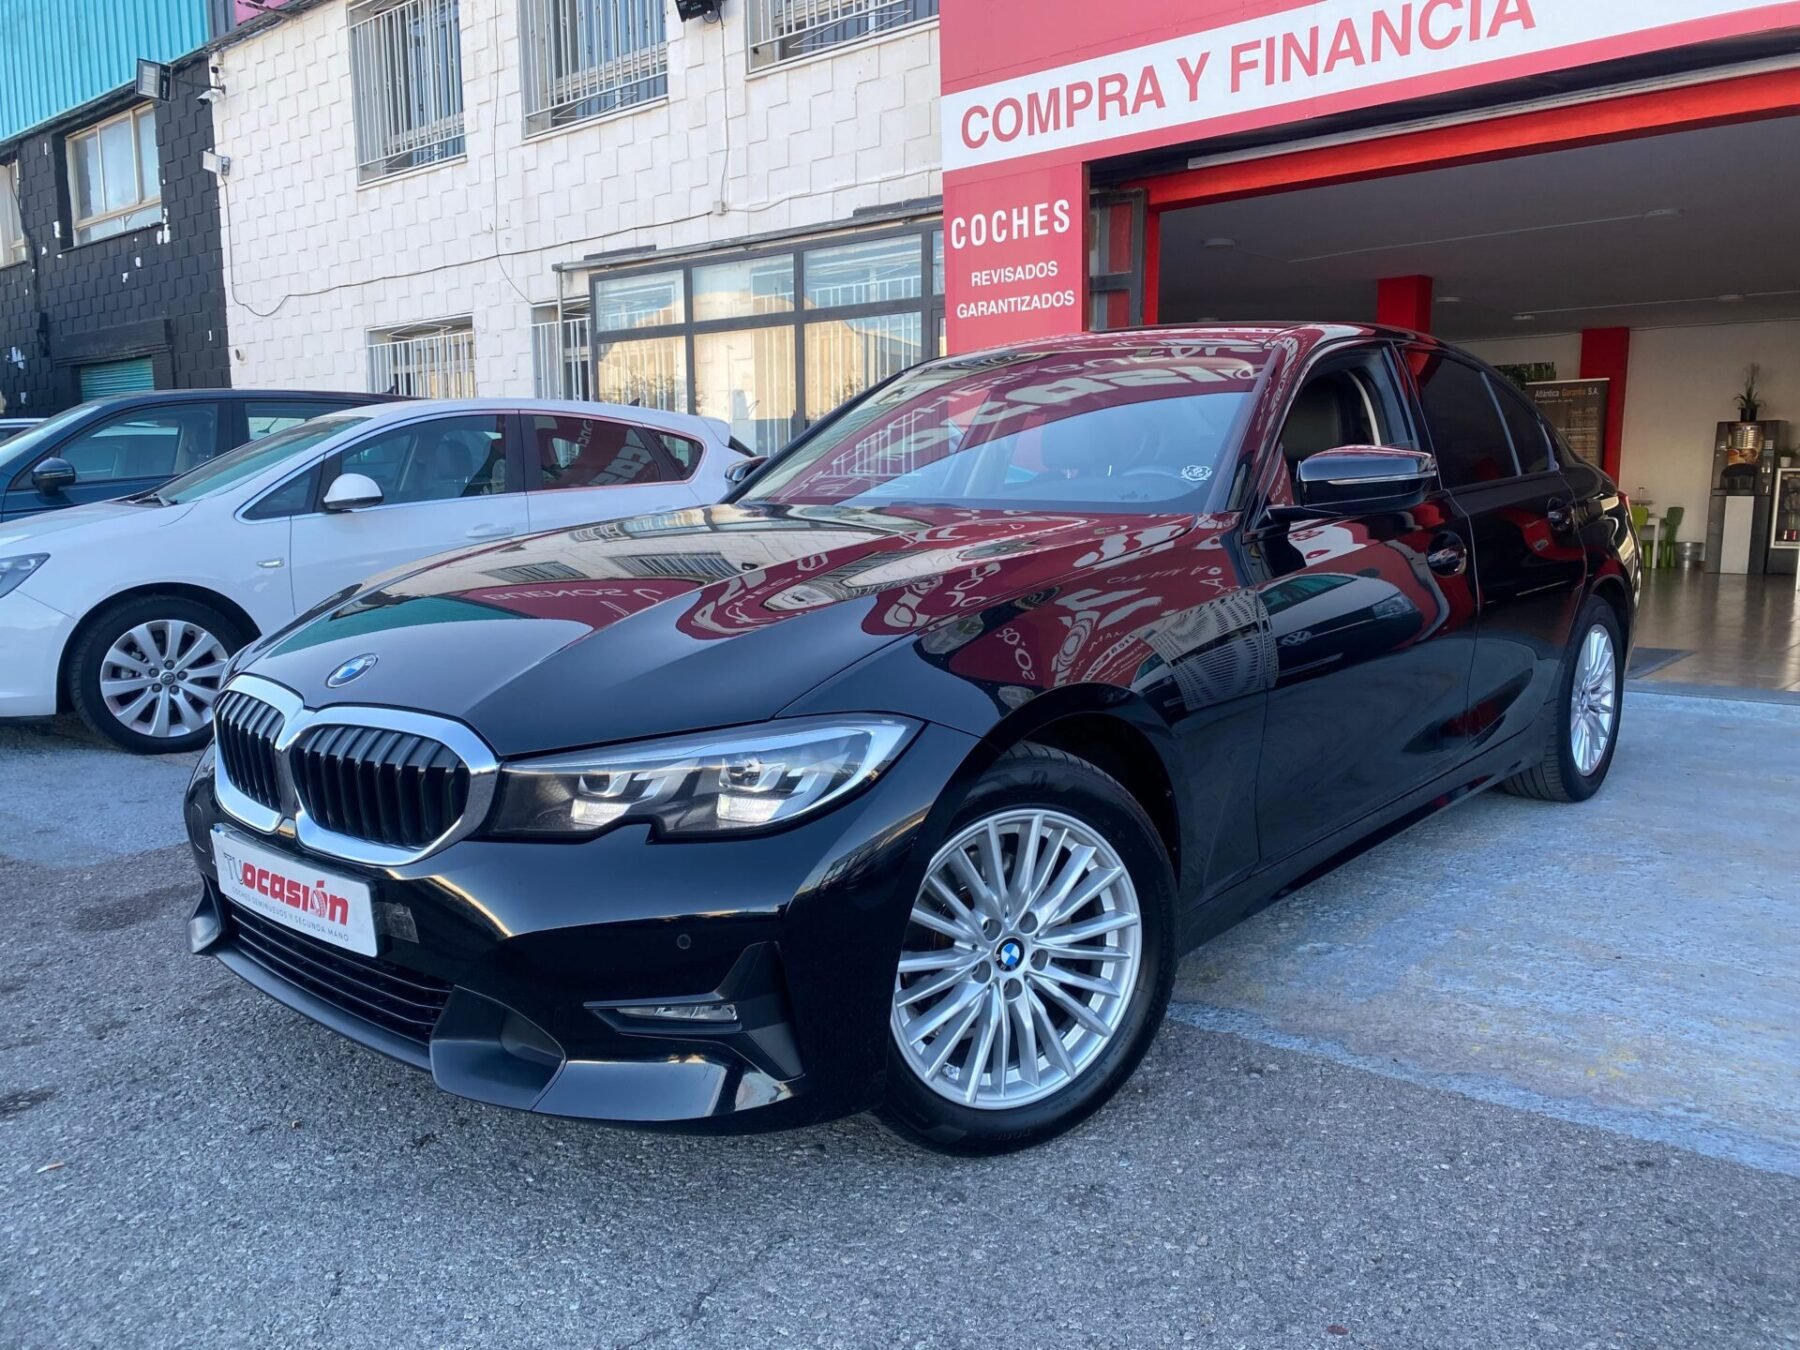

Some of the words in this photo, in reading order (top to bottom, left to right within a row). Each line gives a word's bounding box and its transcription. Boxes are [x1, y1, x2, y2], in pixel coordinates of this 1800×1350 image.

[961, 65, 1166, 149] COMPRA
[1176, 52, 1211, 101] Y
[1231, 0, 1536, 93] FINANCIA
[951, 199, 1070, 249] COCHES
[971, 260, 1058, 287] REVISADOS
[957, 290, 1075, 318] GARANTIZADOS
